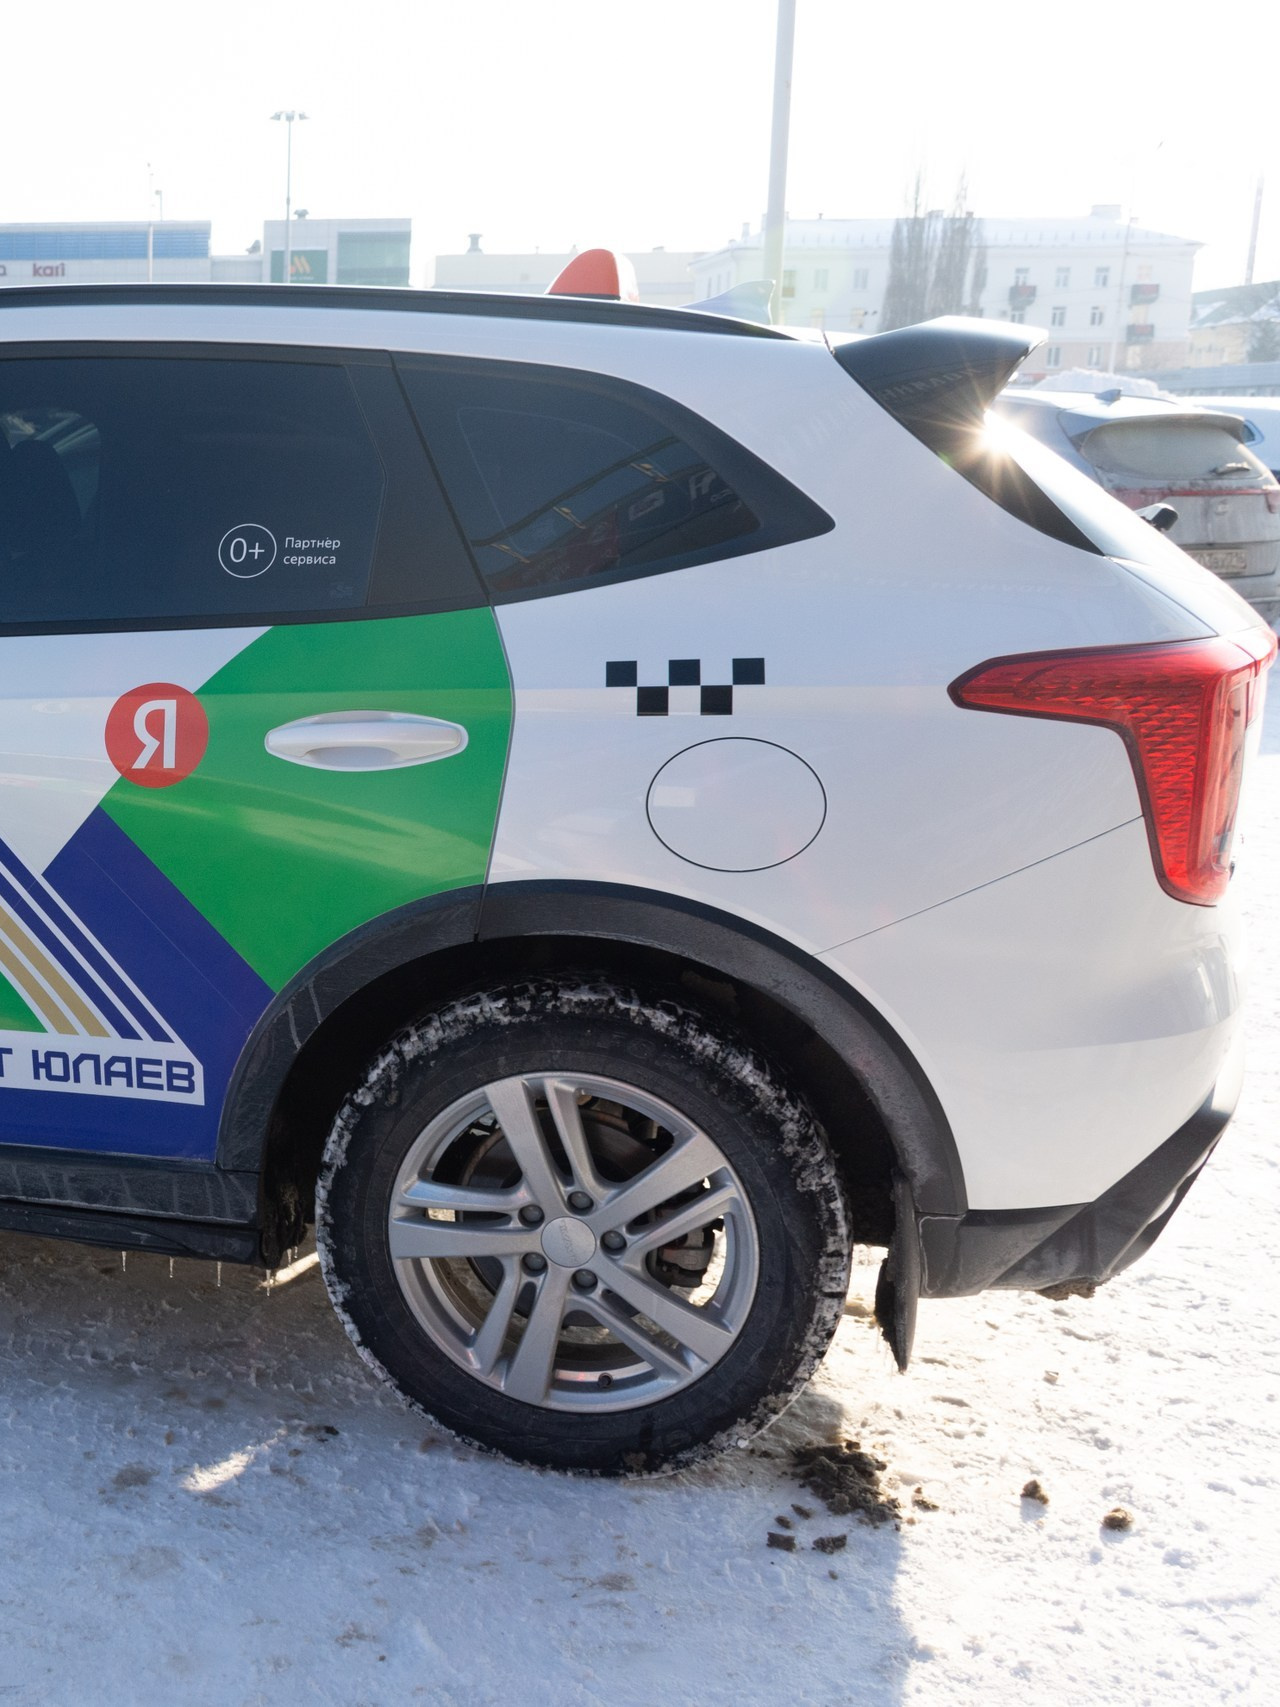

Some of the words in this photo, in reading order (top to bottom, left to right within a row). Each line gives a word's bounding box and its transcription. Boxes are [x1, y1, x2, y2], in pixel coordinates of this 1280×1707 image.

[32, 262, 66, 277] kari
[229, 537, 265, 563] 0+
[283, 555, 336, 567] сервиса
[131, 698, 177, 769] Я
[31, 1049, 196, 1094] ЮЛАЕВ
